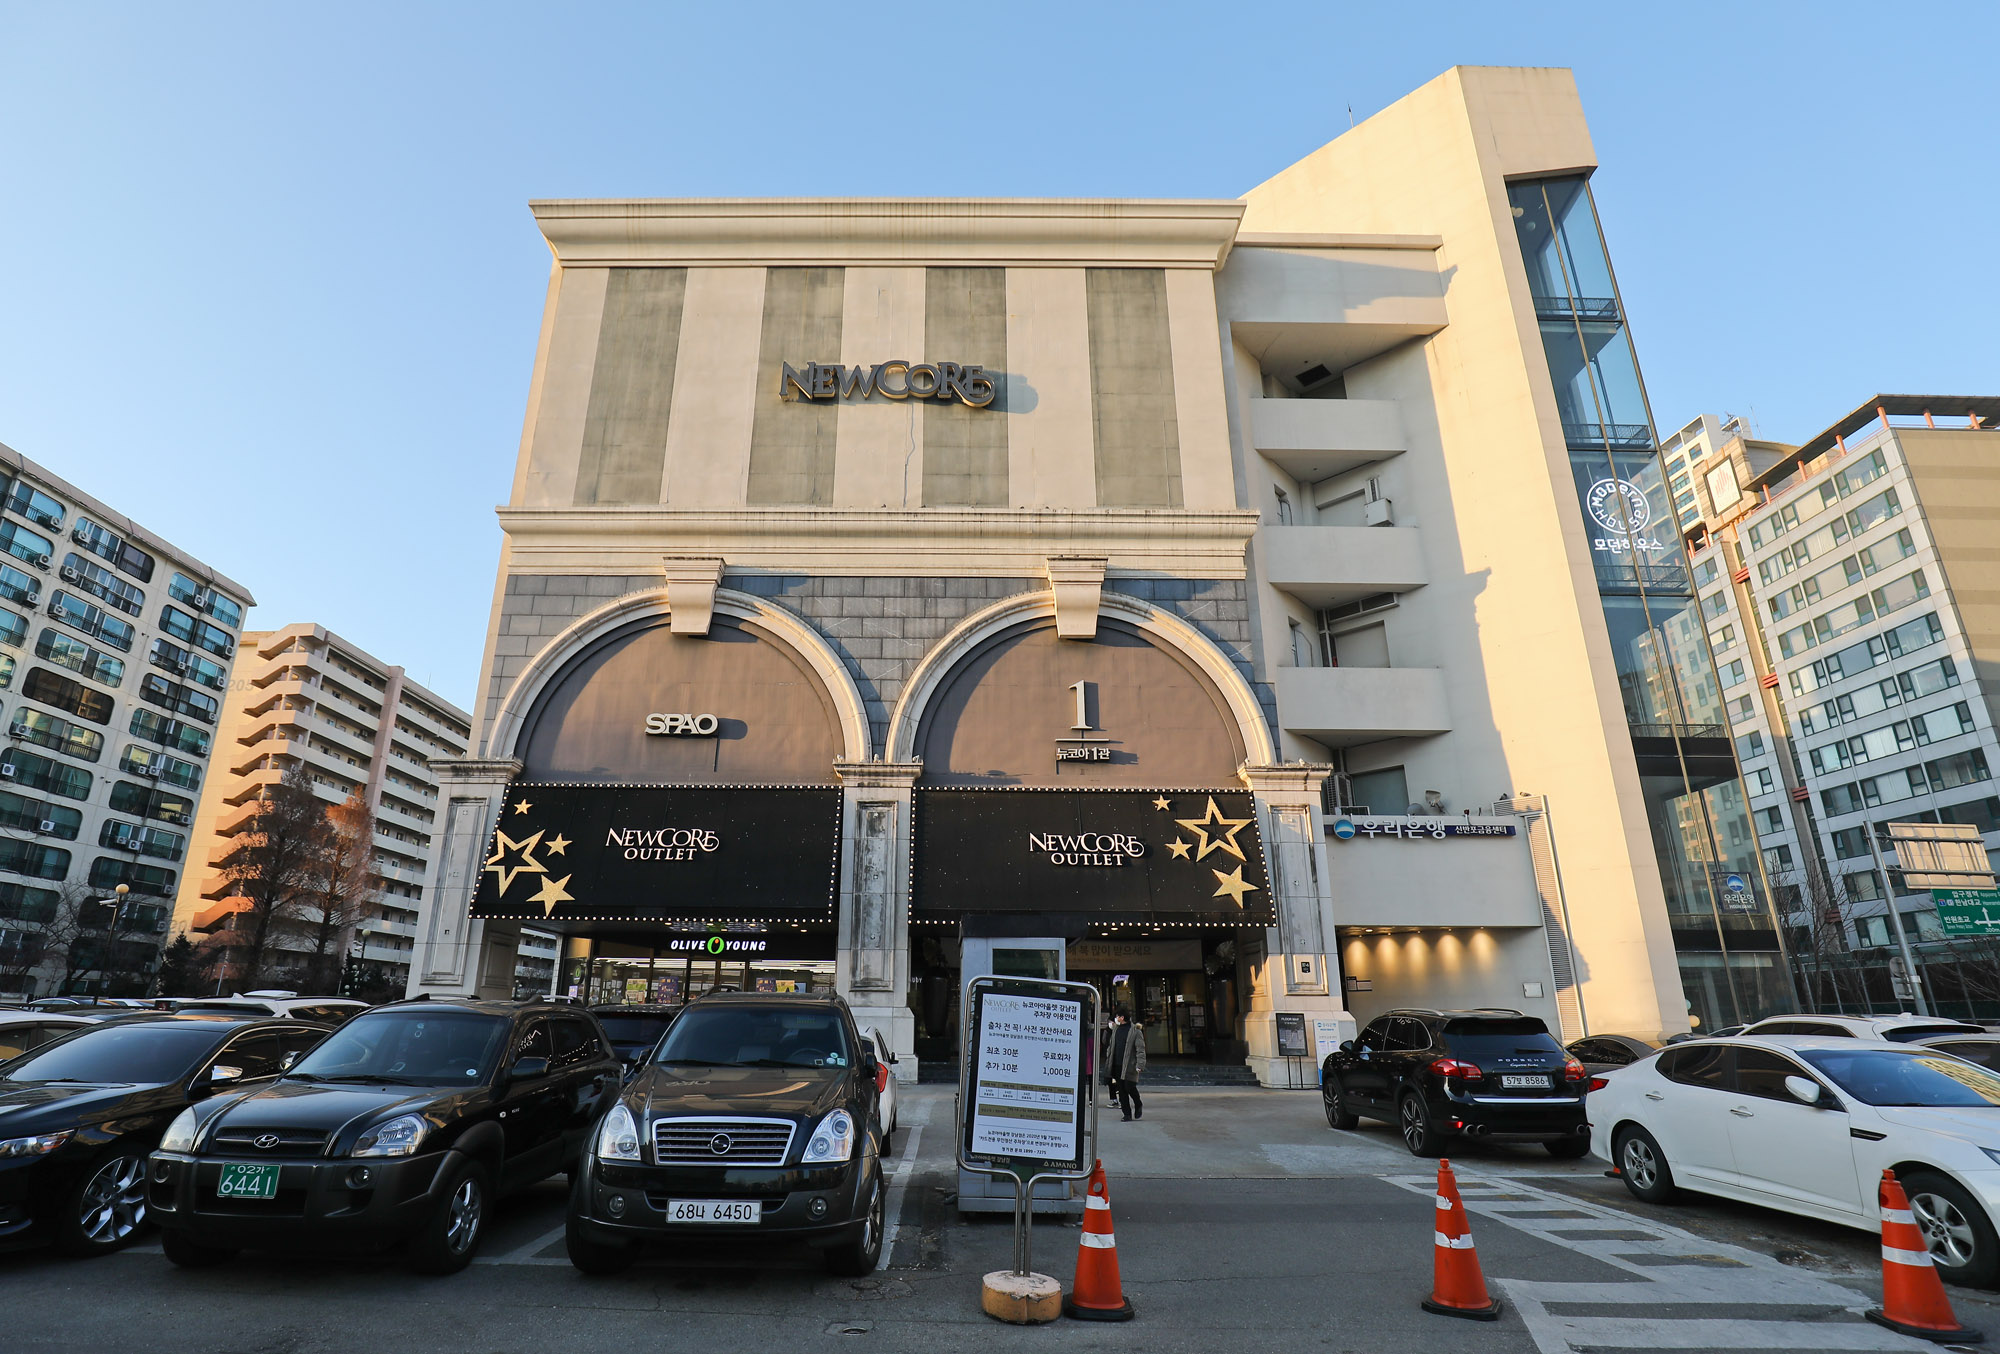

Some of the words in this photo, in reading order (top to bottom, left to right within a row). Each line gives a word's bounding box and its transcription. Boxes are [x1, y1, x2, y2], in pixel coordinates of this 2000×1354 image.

[778, 359, 996, 408] NEWCORE
[1594, 538, 1665, 554] 모던하우스
[1068, 679, 1093, 730] 1
[645, 713, 719, 735] SPAO
[1056, 746, 1089, 761] 뉴코아
[1091, 747, 1111, 761] 1관
[1361, 818, 1447, 840] 우리은행
[1455, 825, 1508, 835] 신반포금융센터
[605, 827, 720, 852] NEWCORE
[1029, 832, 1145, 858] NEWCORE
[624, 847, 698, 861] OUTLET
[1050, 852, 1124, 866] OUTLET
[1724, 893, 1755, 904] 우리은행
[670, 940, 706, 950] OLIVE
[726, 940, 767, 951] YOUNG
[1022, 1001, 1058, 1012] 뉴코아아울렛
[1059, 1005, 1077, 1013] 강남점
[1033, 1011, 1052, 1019] 주차장
[1053, 1013, 1077, 1021] 이용안내
[988, 1021, 1002, 1030] 출차
[1003, 1023, 1011, 1031] 전
[1012, 1023, 1022, 1032] 꼭!
[1023, 1025, 1038, 1034] 사전
[1039, 1026, 1073, 1036] 정산하세요
[986, 1046, 1001, 1055] 최초
[1003, 1048, 1019, 1058] 30분
[1043, 1051, 1071, 1062] 무료회차
[985, 1061, 1000, 1071] 추가
[1002, 1063, 1018, 1073] 10분
[1043, 1067, 1071, 1077] 1,000원
[1525, 1077, 1546, 1085] 8586
[237, 1165, 265, 1174] 02가
[1050, 1161, 1077, 1170] AMANO
[221, 1174, 272, 1195] 6441
[676, 1204, 706, 1219] 68나
[713, 1204, 752, 1220] 6450
